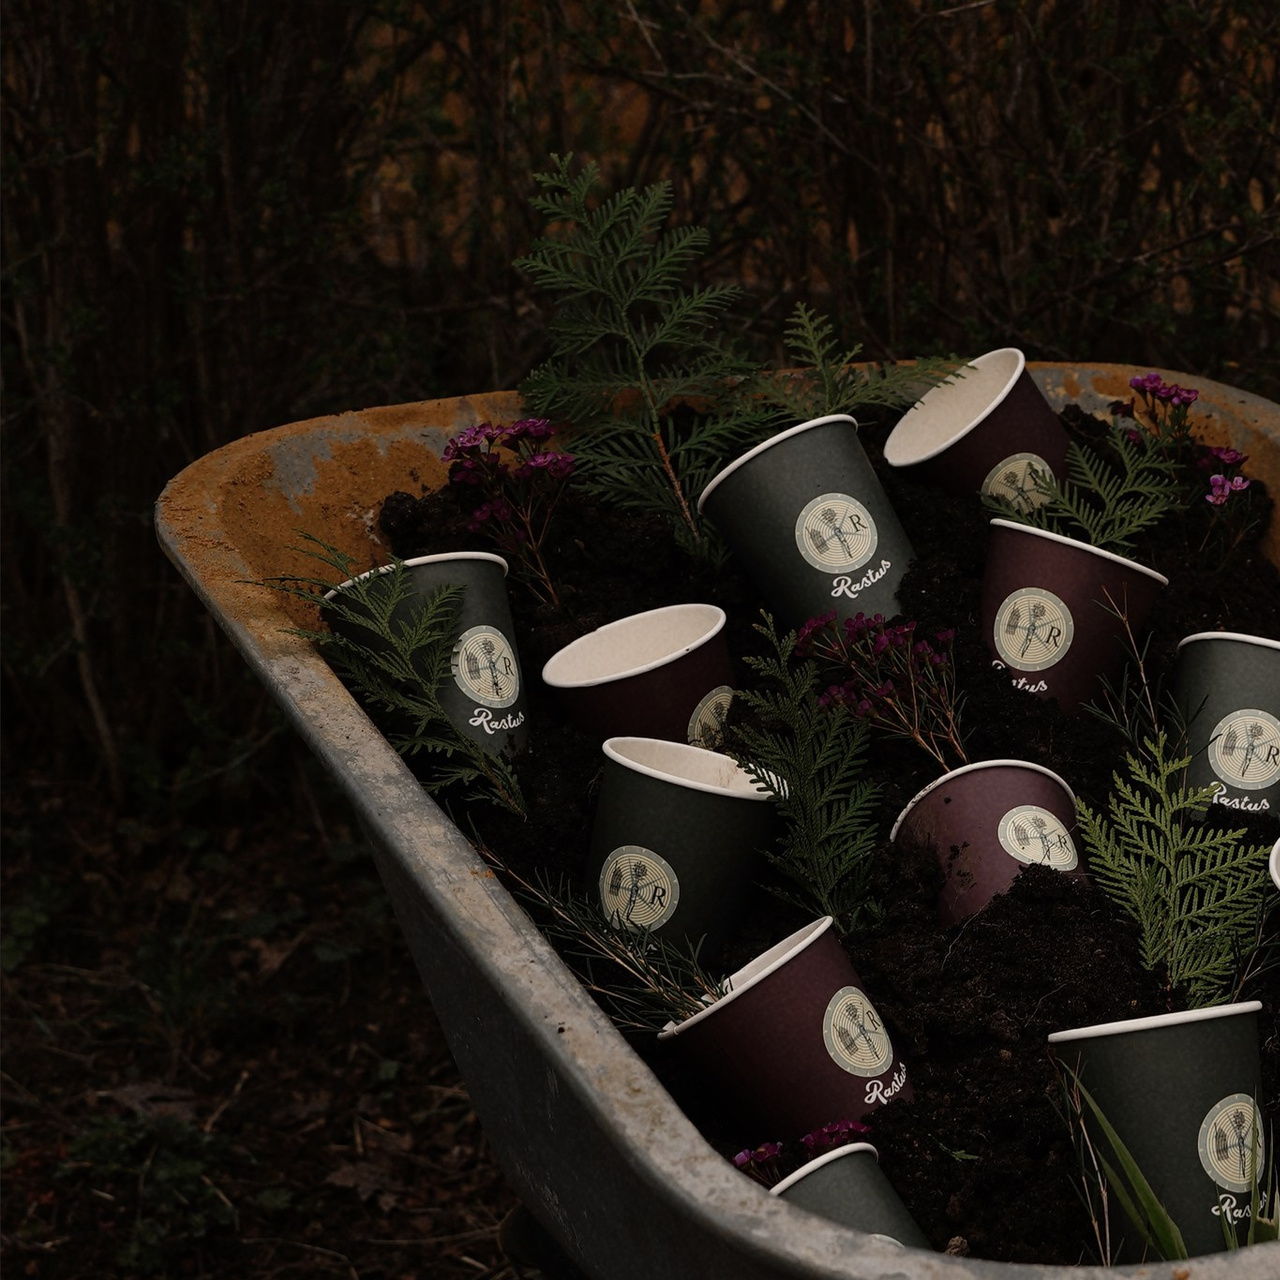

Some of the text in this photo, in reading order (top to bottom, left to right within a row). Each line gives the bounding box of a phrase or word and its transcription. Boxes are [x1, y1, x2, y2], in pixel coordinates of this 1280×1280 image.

[848, 513, 869, 533] R
[830, 559, 892, 599] Rastus
[1046, 624, 1062, 649] R
[468, 707, 526, 735] Rastus
[1265, 744, 1280, 767] R
[650, 885, 666, 909] R
[863, 1061, 907, 1105] Rastus
